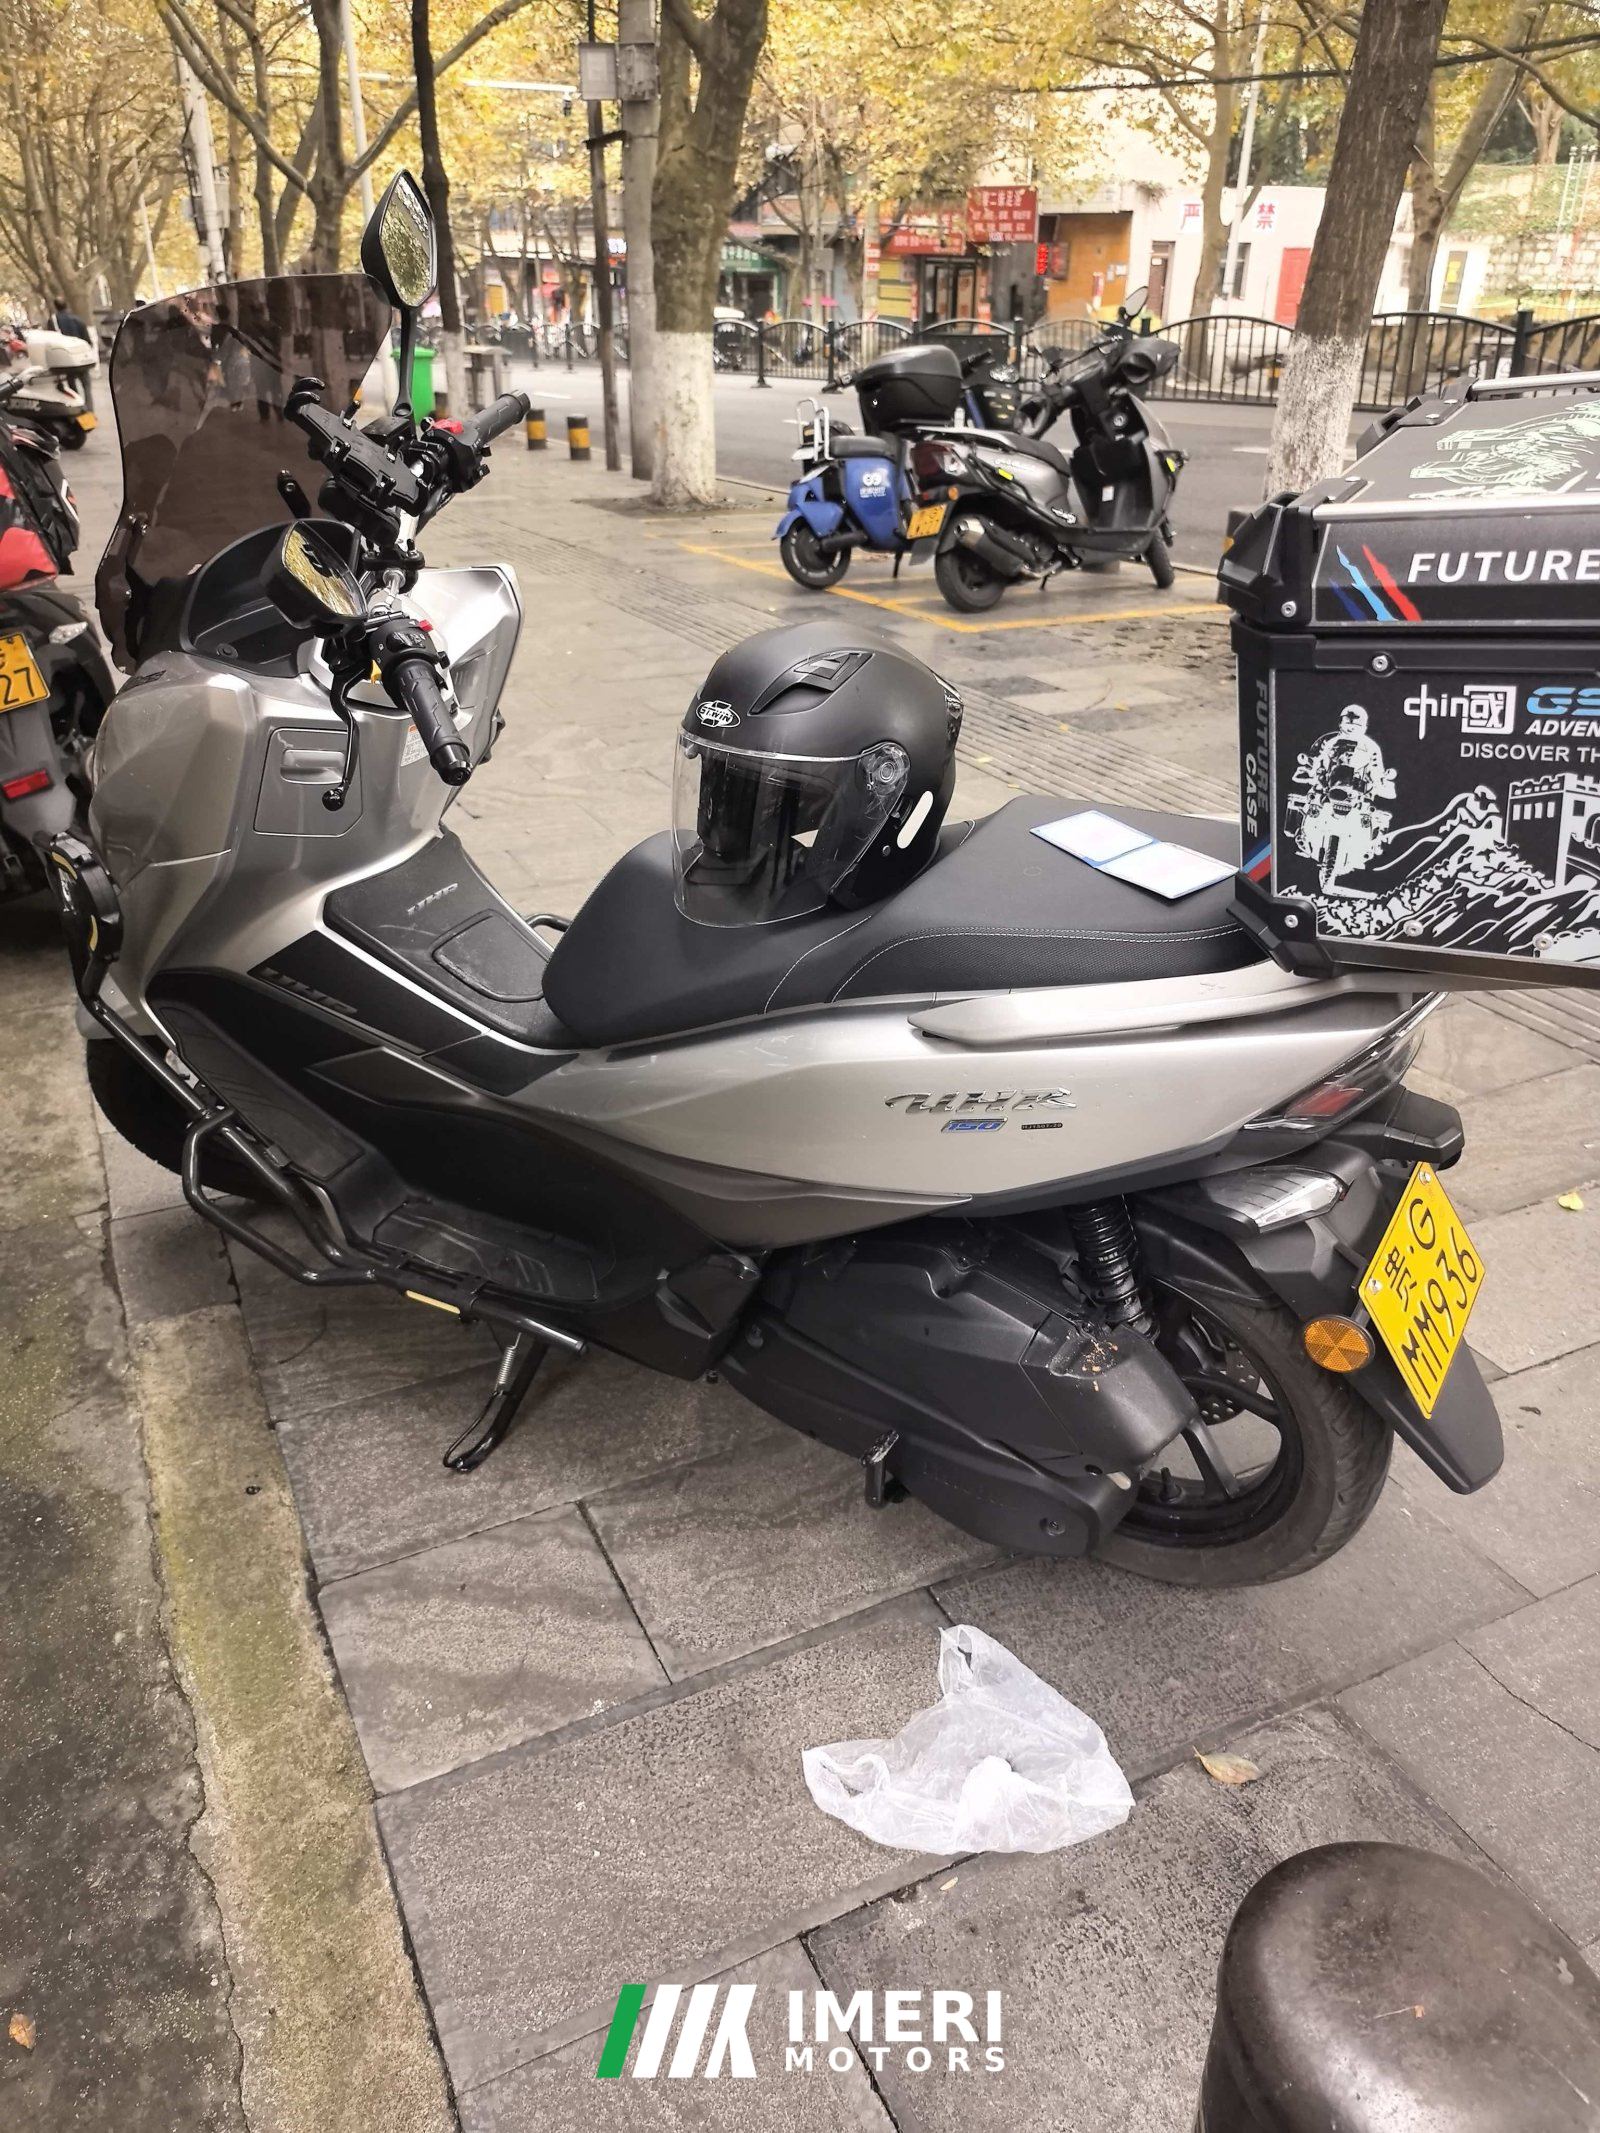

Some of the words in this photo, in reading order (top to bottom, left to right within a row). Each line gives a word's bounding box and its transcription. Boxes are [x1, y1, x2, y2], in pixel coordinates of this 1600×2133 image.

[1181, 203, 1201, 229] 严
[1256, 203, 1275, 229] 禁
[1408, 549, 1600, 583] FUTURE
[1256, 680, 1269, 813] FUTURE
[1460, 742, 1569, 763] DISCOVER
[1246, 753, 1258, 838] CASE
[946, 1119, 1002, 1132] 150
[1402, 1226, 1477, 1400] MM936
